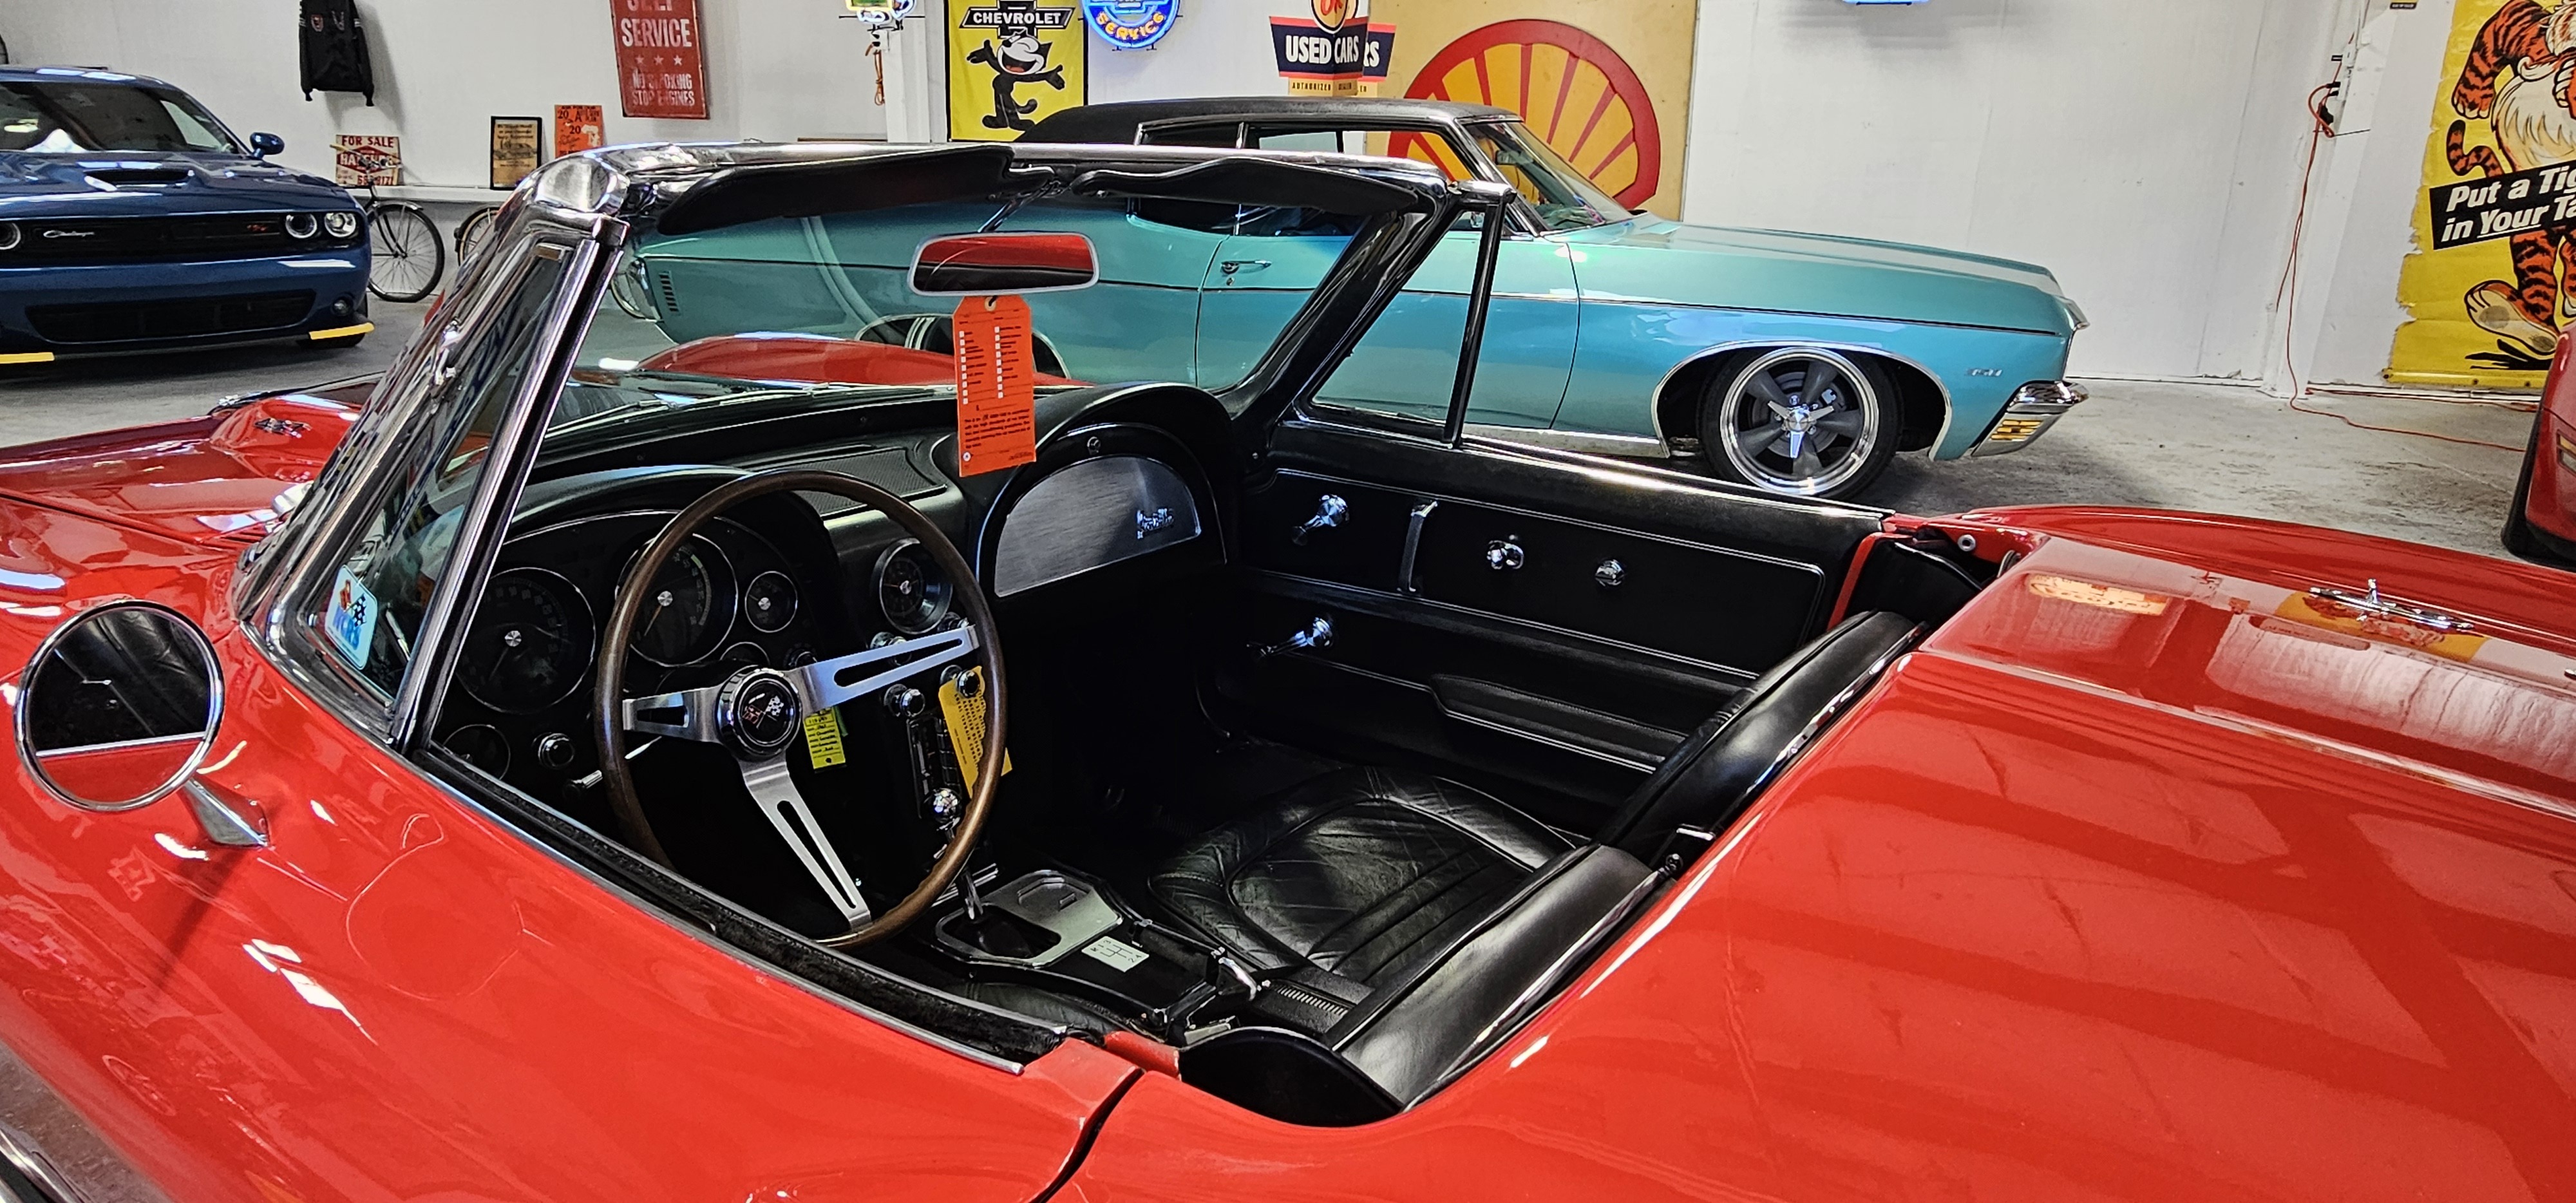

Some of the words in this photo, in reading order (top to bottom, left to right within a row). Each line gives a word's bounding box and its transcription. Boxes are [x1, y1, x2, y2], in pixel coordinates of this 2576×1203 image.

[620, 18, 692, 47] SERVICE
[973, 12, 1061, 24] CHEVROLET
[1285, 35, 1332, 64] USED
[1334, 35, 1359, 64] CARS
[341, 135, 363, 146] FOR
[368, 137, 394, 148] SALE
[2446, 181, 2502, 213] Put
[2508, 178, 2531, 200] a
[2441, 217, 2474, 242] in
[2481, 205, 2550, 236] Your
